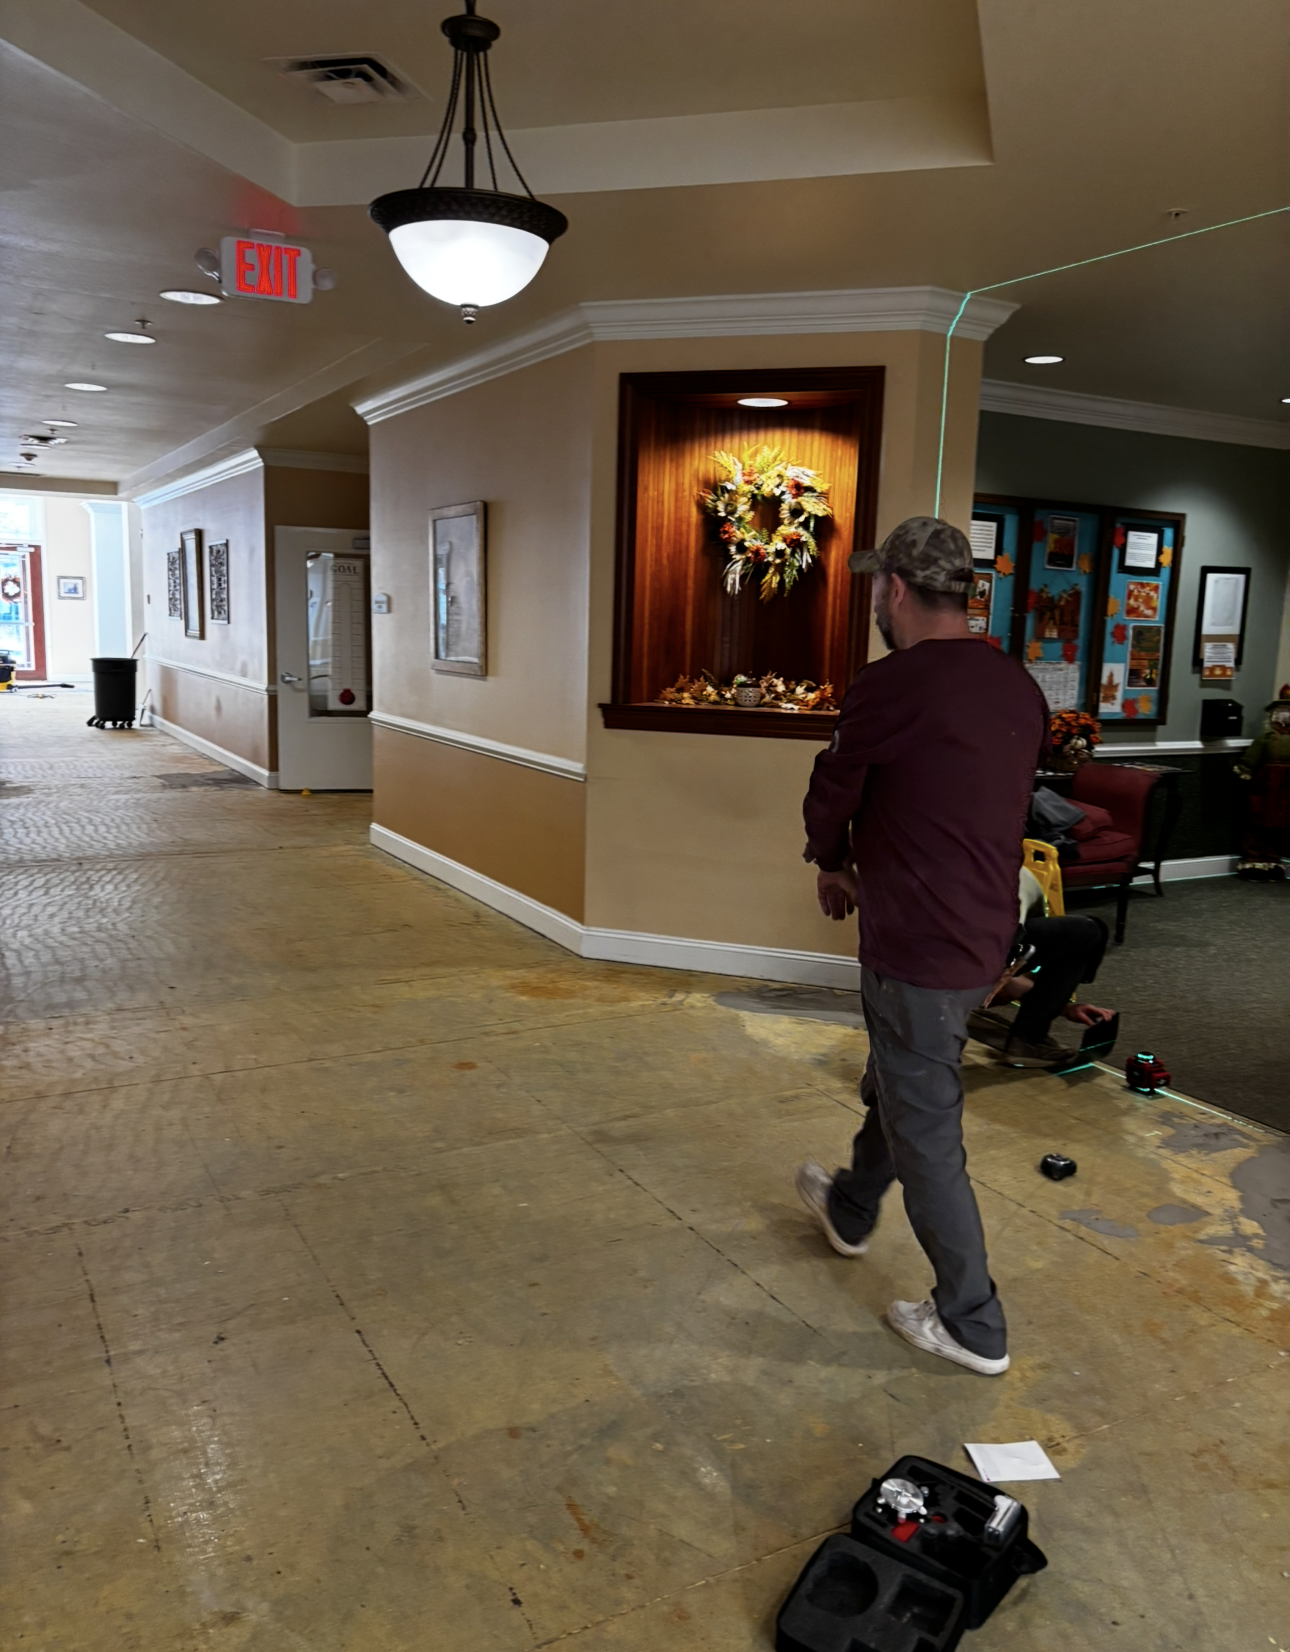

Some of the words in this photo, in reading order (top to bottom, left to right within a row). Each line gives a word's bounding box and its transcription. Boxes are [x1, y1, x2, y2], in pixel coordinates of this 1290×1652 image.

[236, 240, 301, 299] EXIT
[330, 564, 359, 575] GOAL
[1038, 605, 1078, 628] FALL
